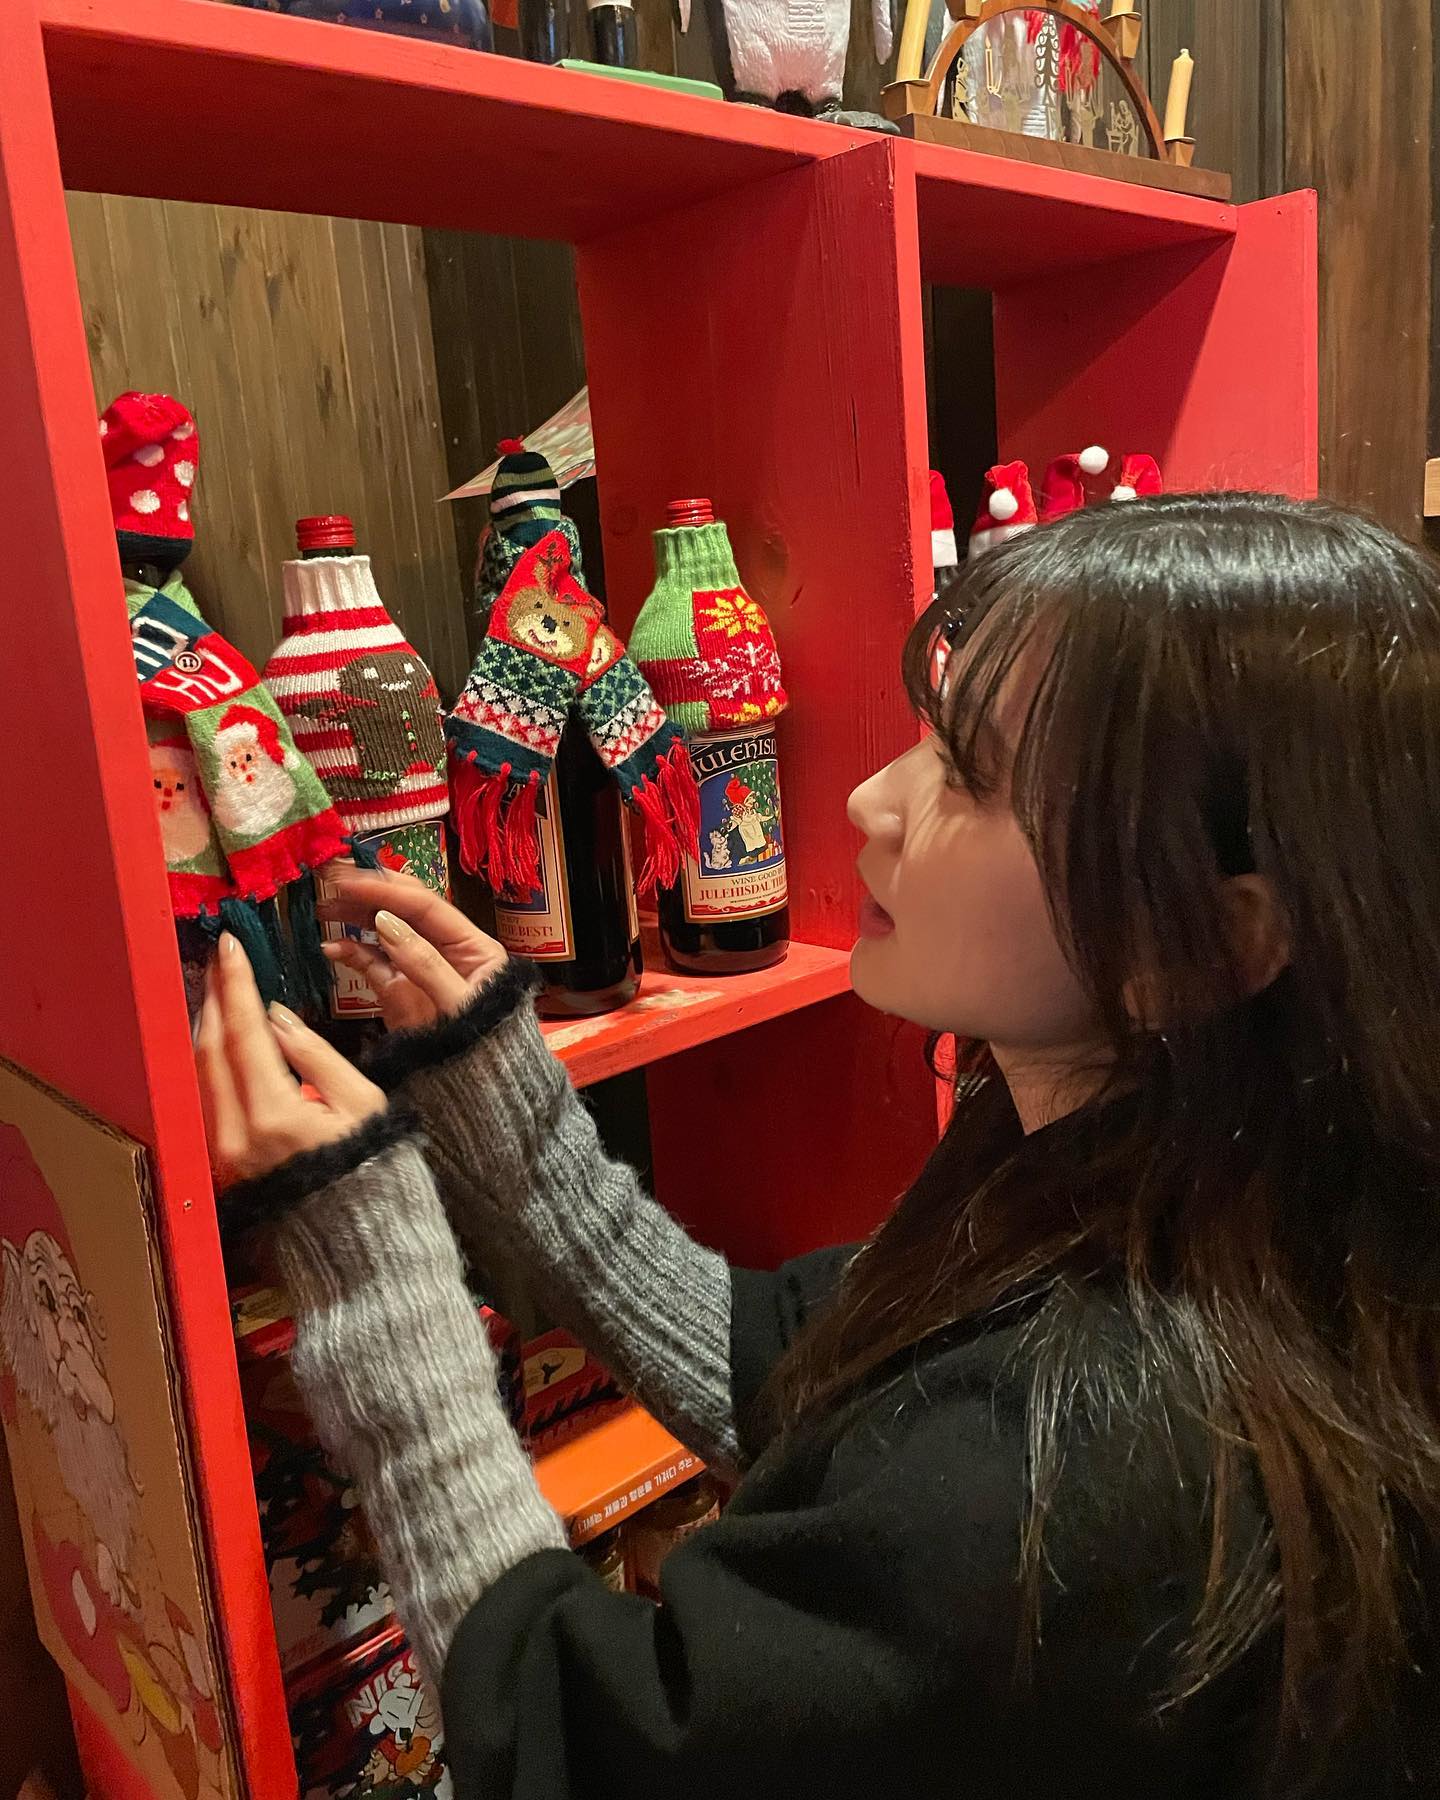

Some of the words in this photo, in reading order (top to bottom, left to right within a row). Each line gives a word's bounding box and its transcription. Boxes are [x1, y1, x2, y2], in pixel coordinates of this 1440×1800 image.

[731, 876, 757, 886] WINE
[757, 869, 778, 881] GOOD
[700, 881, 771, 901] JULEHISDAL
[519, 926, 553, 937] BEST!
[678, 1457, 693, 1472] 주는
